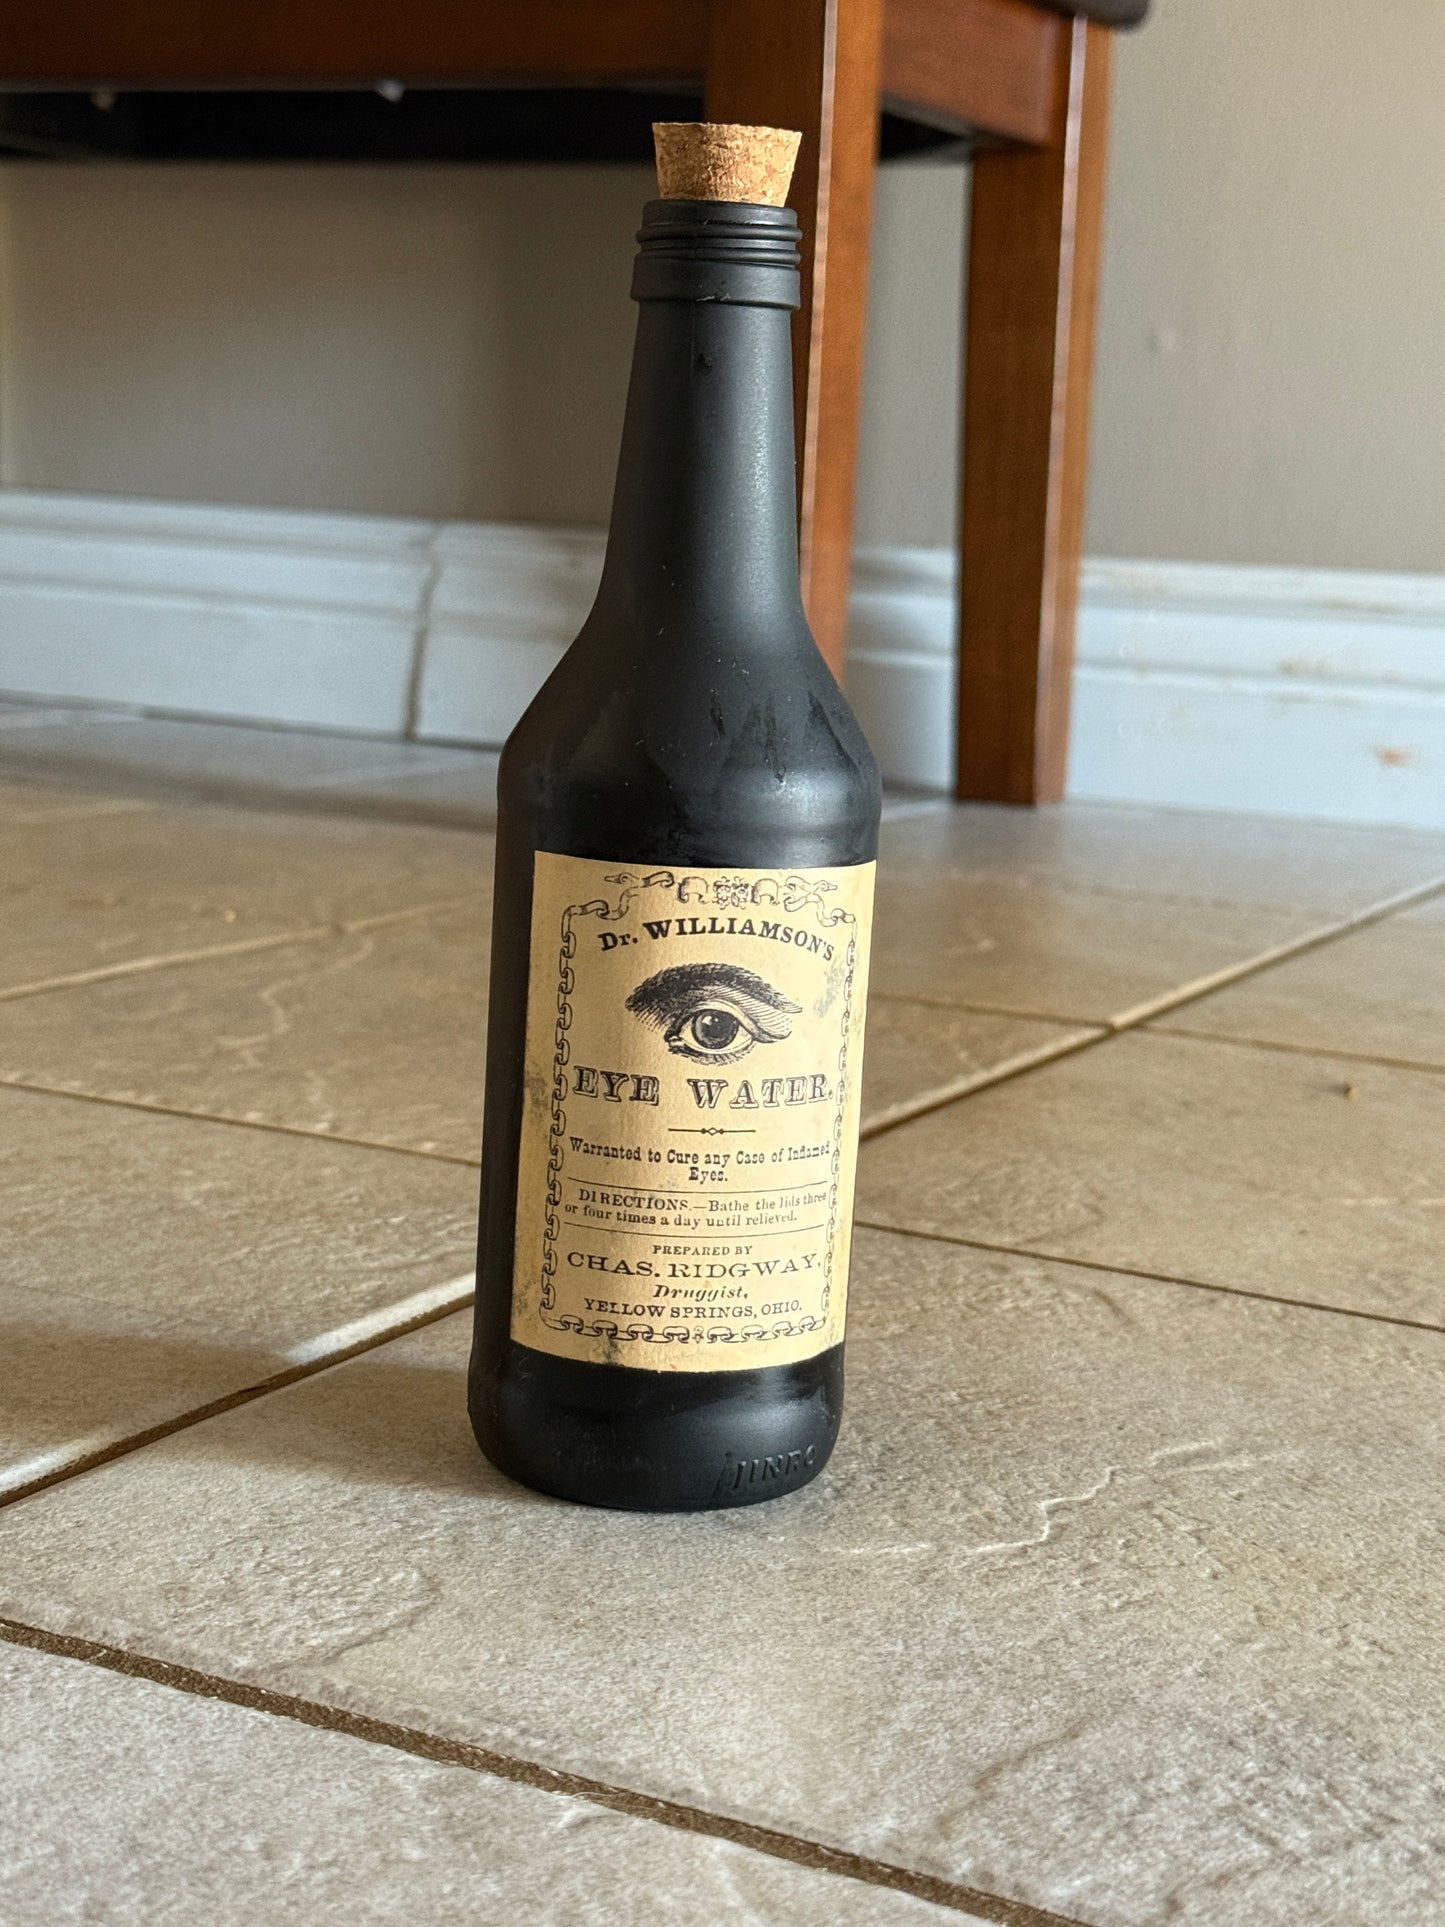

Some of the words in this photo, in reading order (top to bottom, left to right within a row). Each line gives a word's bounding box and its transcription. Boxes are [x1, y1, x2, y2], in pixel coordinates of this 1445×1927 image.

[598, 931, 638, 951] Dr.
[642, 917, 835, 962] WILLIAMSON'S
[572, 1065, 660, 1106] EYE
[686, 1073, 834, 1109] WATER.
[569, 1136, 642, 1162] Warranted
[648, 1148, 661, 1163] to
[667, 1149, 699, 1164] Cure
[704, 1153, 731, 1168] any
[736, 1150, 765, 1165] Case
[771, 1148, 784, 1163] of
[688, 1166, 728, 1185] Eyes.
[755, 1198, 776, 1211] the
[779, 1196, 801, 1209] lids
[803, 1192, 827, 1205] three
[564, 1203, 578, 1215] or
[583, 1205, 612, 1220] four
[616, 1210, 656, 1225] times
[660, 1216, 670, 1226] a
[673, 1214, 701, 1231] day
[706, 1214, 741, 1228] until
[746, 1210, 798, 1226] relieved.
[652, 1244, 730, 1257] PREPARED
[734, 1245, 753, 1257] BY
[566, 1251, 661, 1278] CHAS.
[653, 1284, 749, 1303] Druggist,
[583, 1297, 666, 1318] YELLOW
[670, 1305, 758, 1320] SPRINGS,
[760, 1299, 803, 1317] OHIO.
